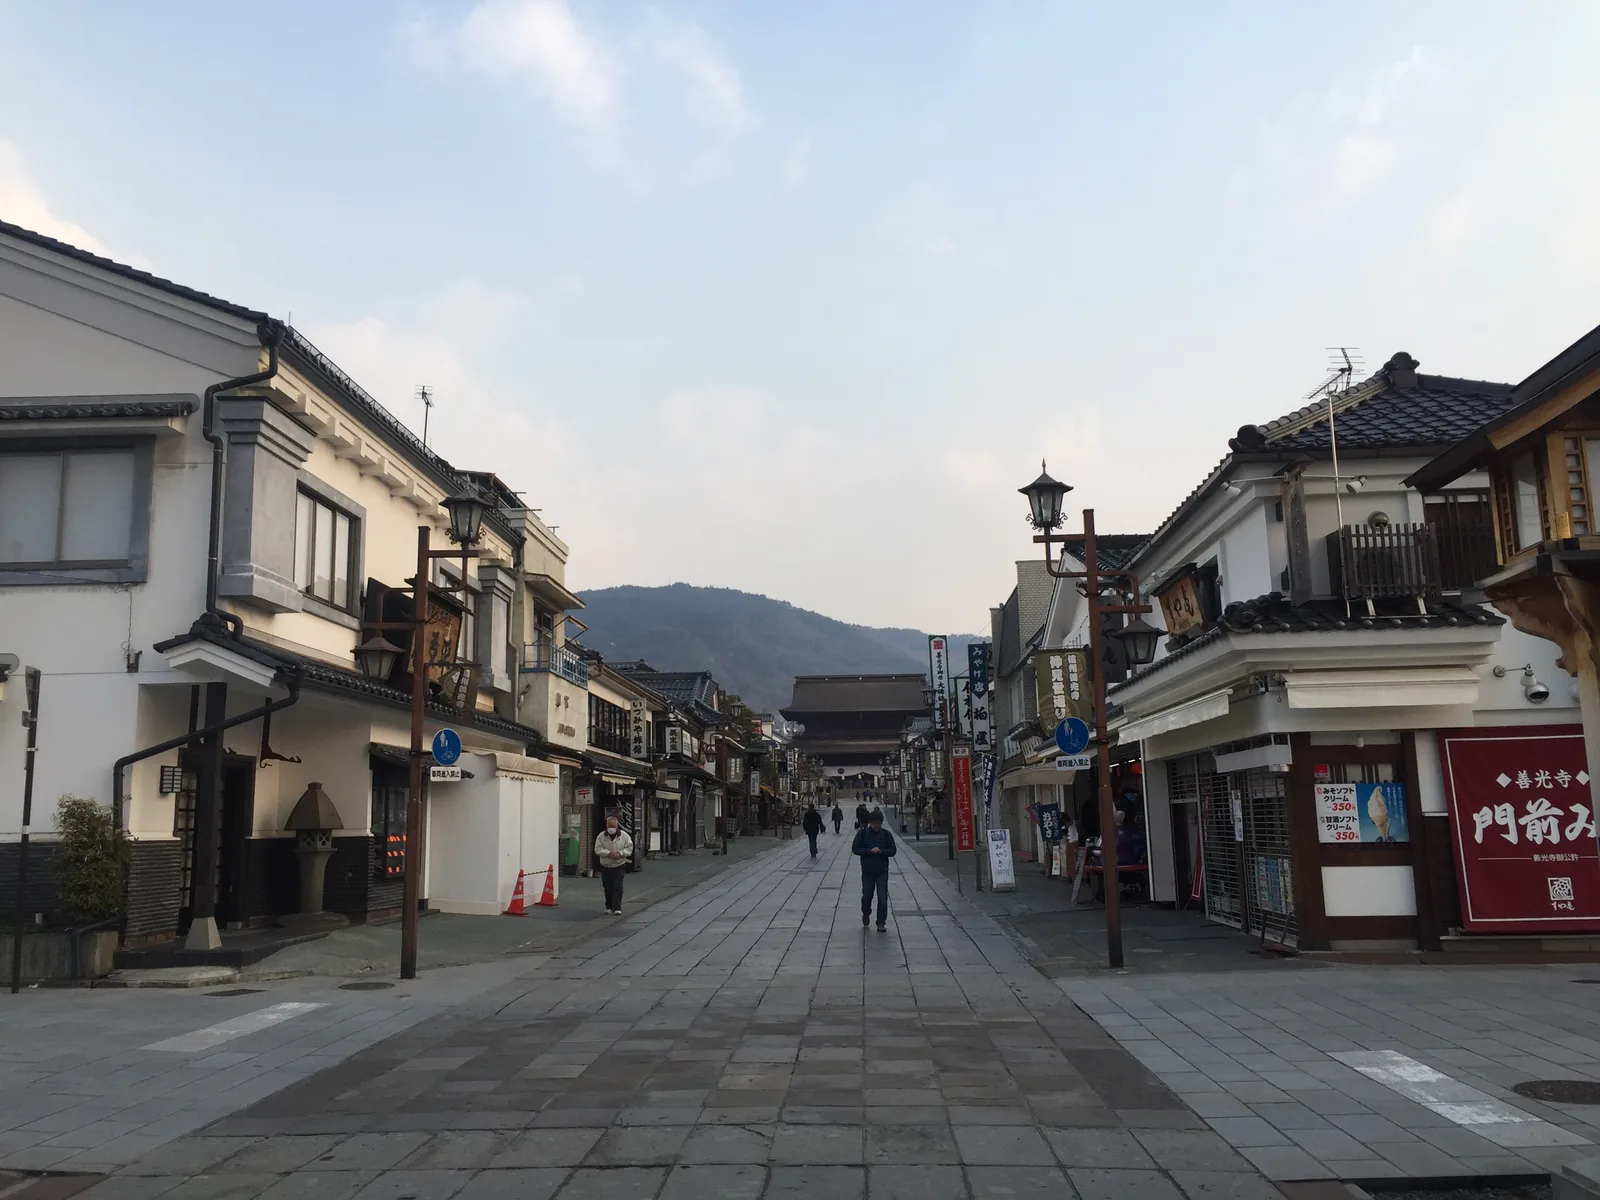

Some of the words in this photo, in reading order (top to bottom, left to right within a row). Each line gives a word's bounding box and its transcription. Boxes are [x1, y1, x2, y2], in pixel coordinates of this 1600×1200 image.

[1057, 759, 1090, 768] 車両進入禁止
[431, 770, 460, 778] 車両進入禁止
[1514, 769, 1573, 790] 善光寺
[1323, 787, 1355, 795] みそソフト
[1325, 815, 1358, 823] 甘酒ソフト
[1042, 811, 1053, 838] おやき
